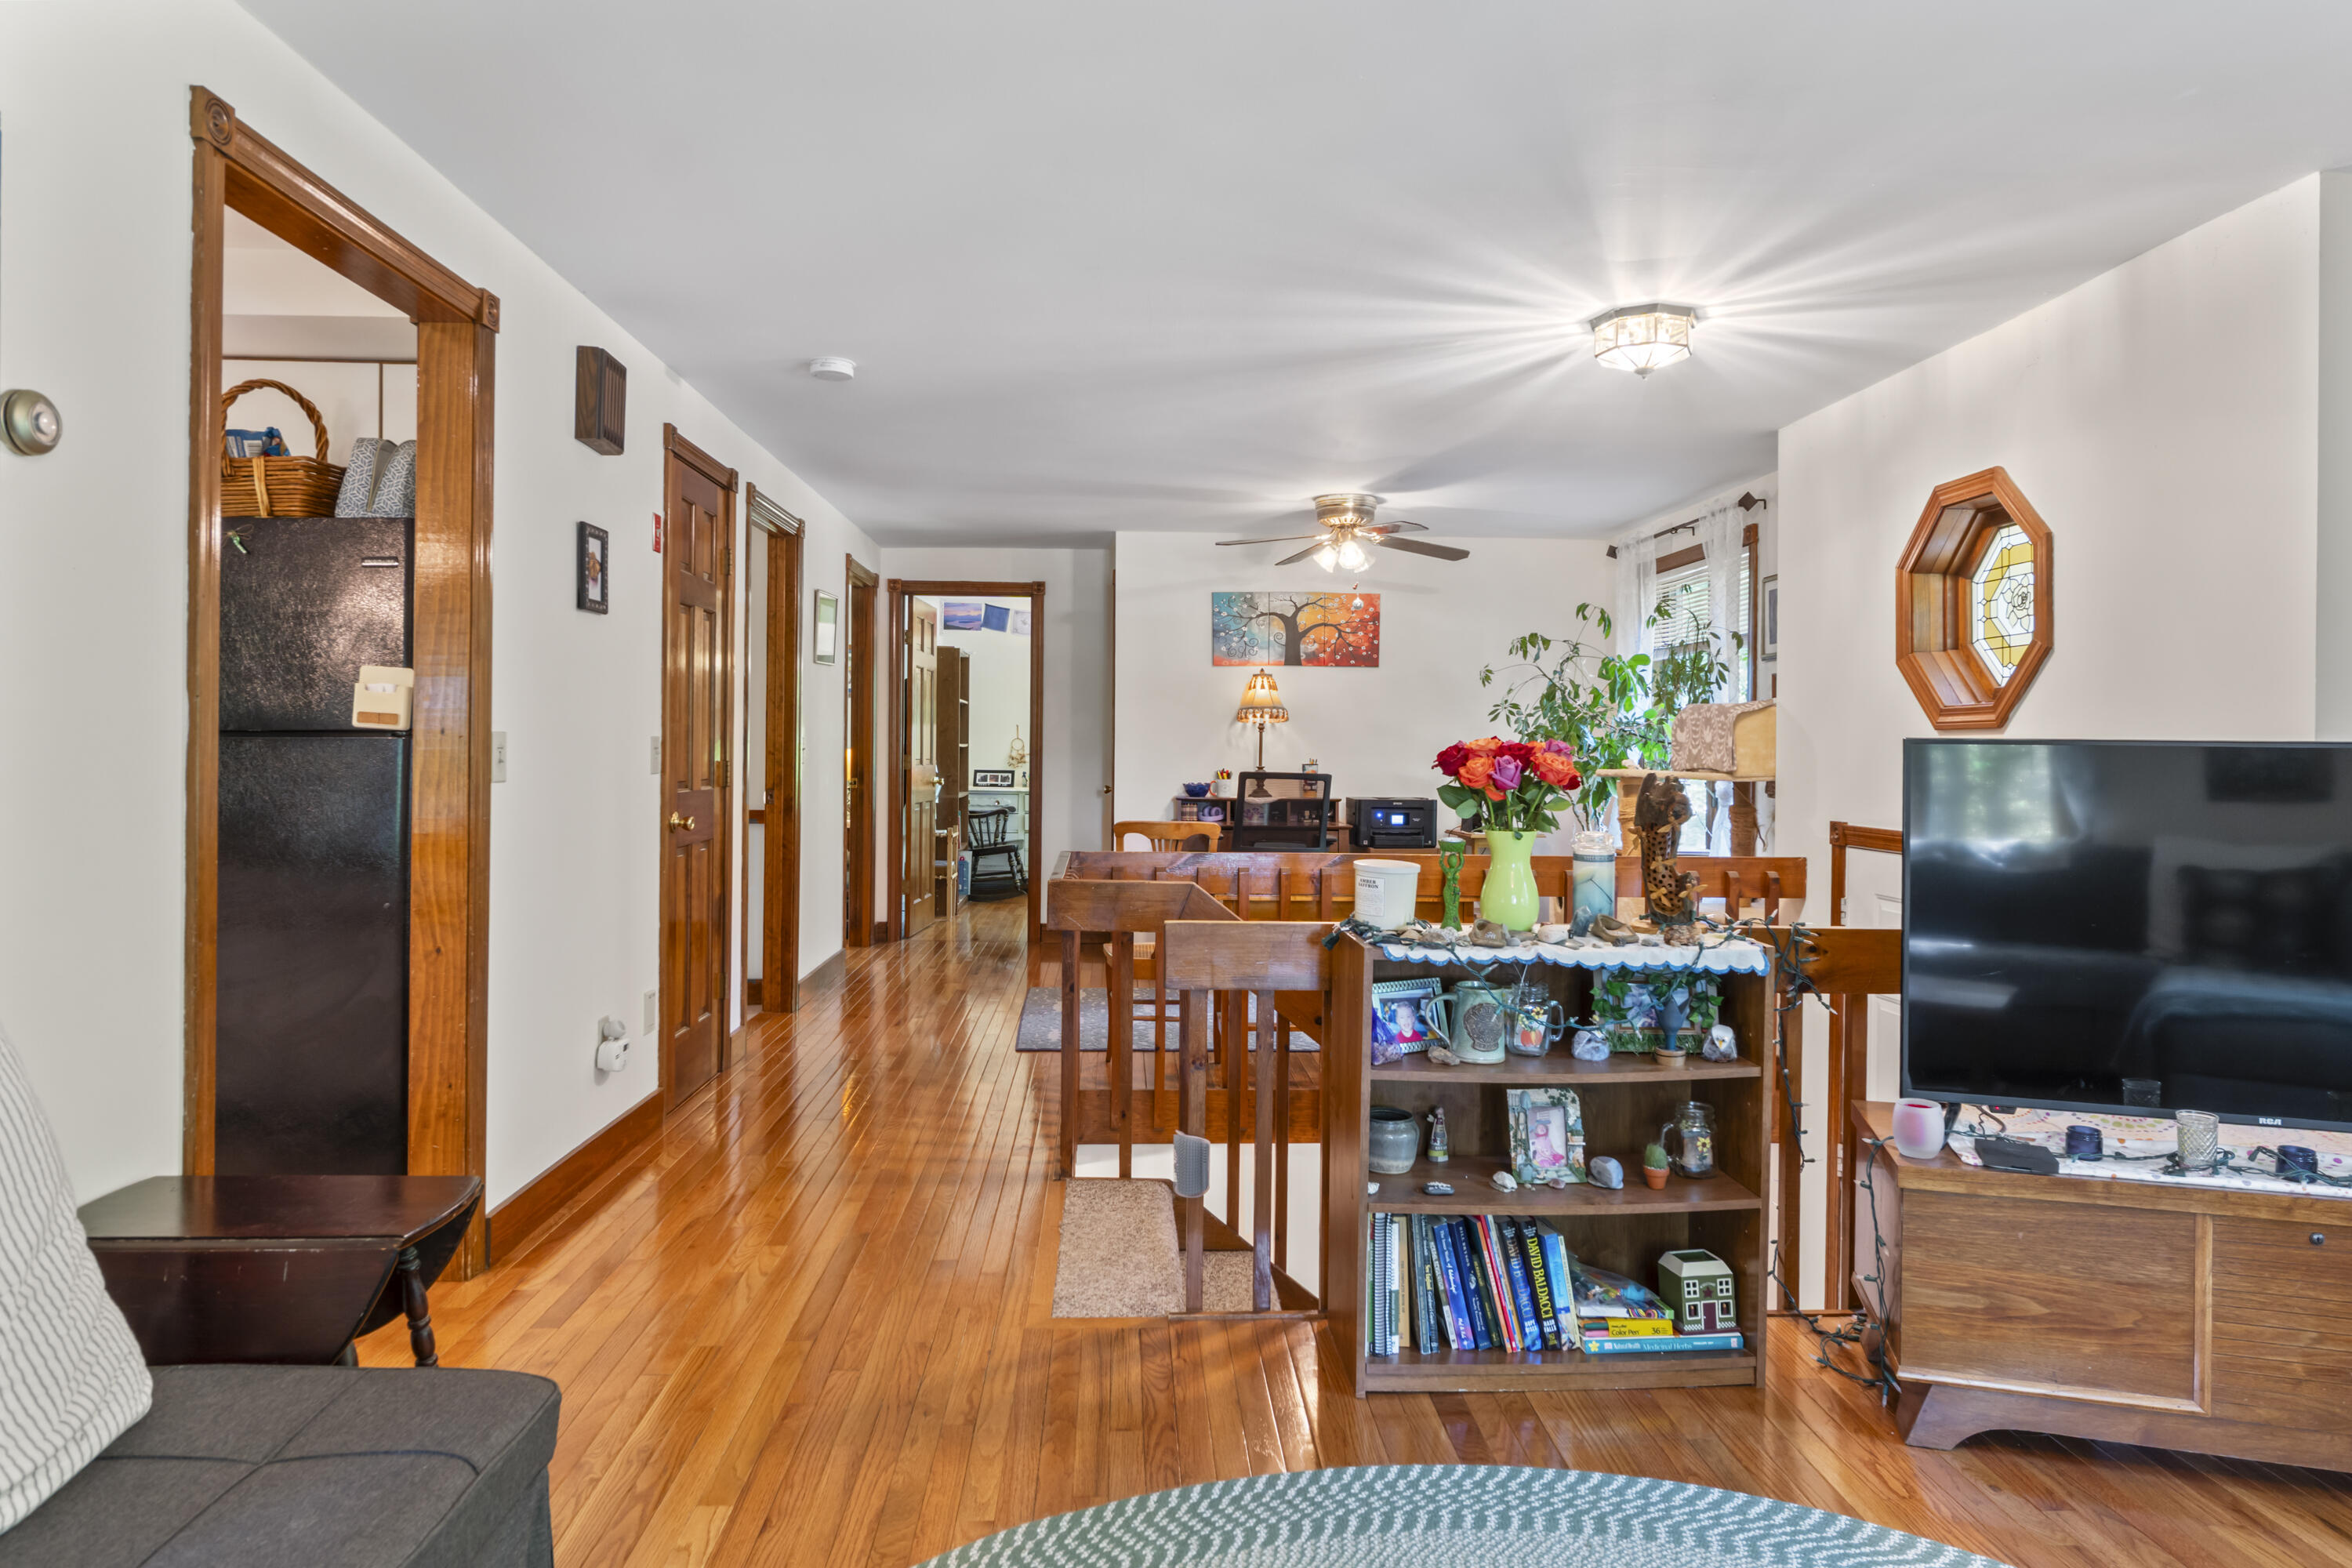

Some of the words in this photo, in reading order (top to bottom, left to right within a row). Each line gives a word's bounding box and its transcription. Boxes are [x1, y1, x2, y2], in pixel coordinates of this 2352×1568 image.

[1462, 1242, 1471, 1267] BRYSON
[1507, 1239, 1522, 1269] DAVID
[1526, 1237, 1543, 1269] DAVID
[1513, 1269, 1534, 1318] BALDACCI
[1533, 1268, 1554, 1319] BALDACCI
[1643, 1342, 1673, 1351] Medicinal
